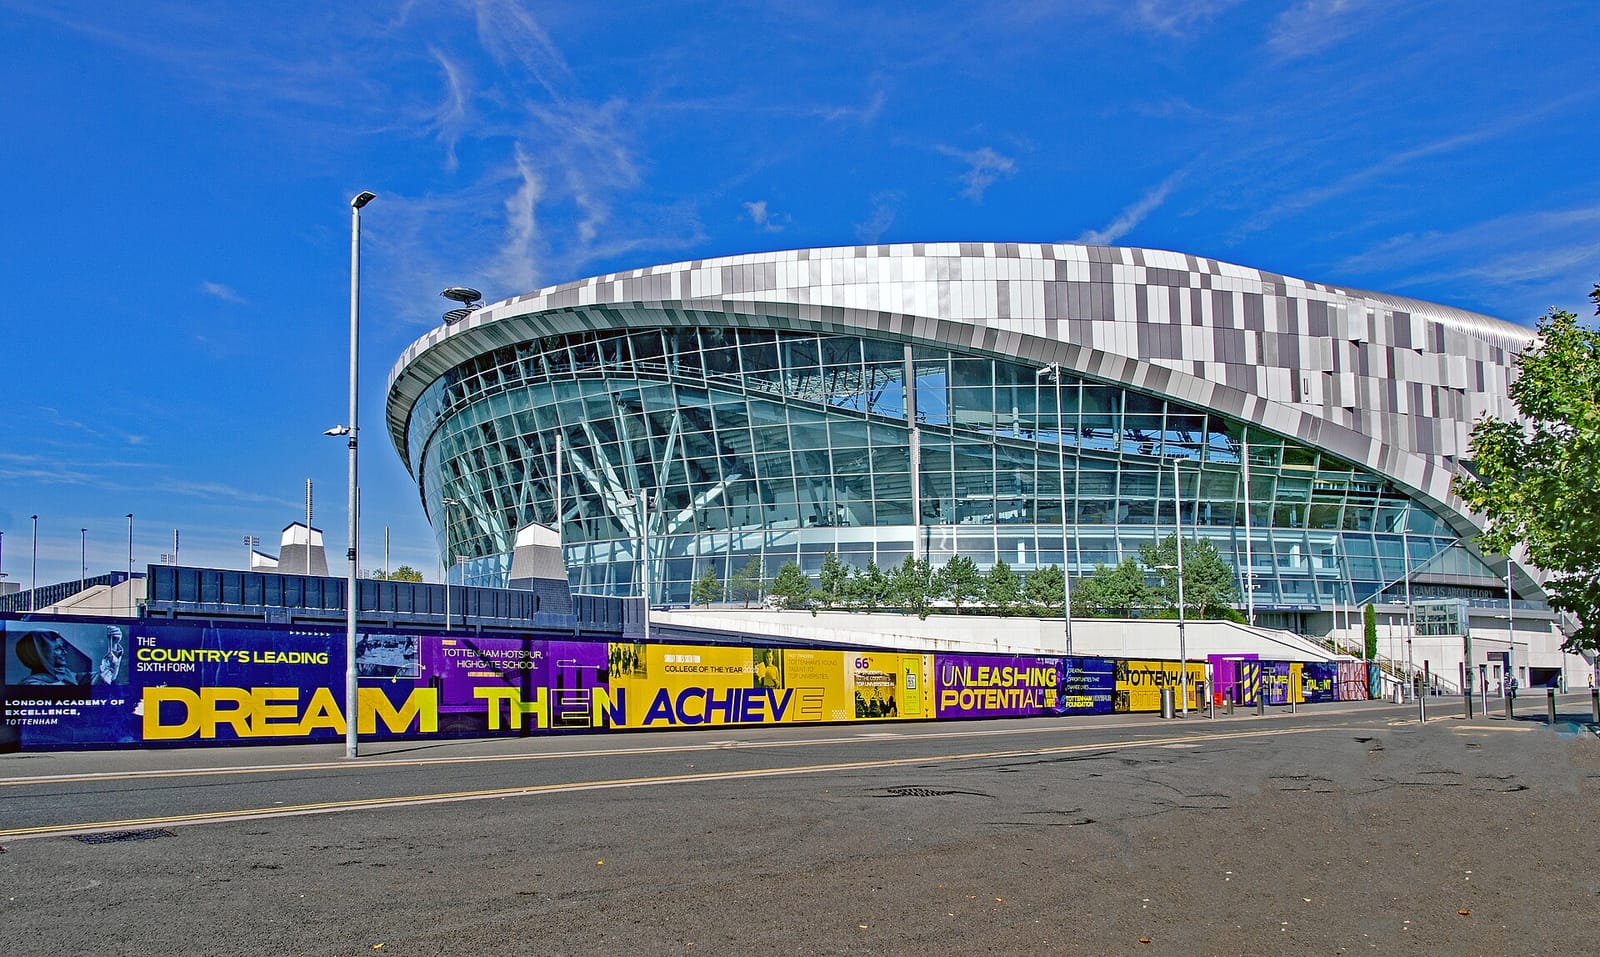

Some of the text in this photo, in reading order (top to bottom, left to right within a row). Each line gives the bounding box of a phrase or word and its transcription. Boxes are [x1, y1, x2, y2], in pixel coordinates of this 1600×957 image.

[1413, 585, 1436, 596] GAME
[1437, 586, 1445, 596] IS
[1447, 587, 1470, 597] ABOUT
[1471, 588, 1494, 598] GLORY
[137, 637, 156, 647] THE
[137, 648, 329, 665] COUNTRY'S LEADING
[442, 648, 544, 660] TOTTENHAM HOTSPUR,
[137, 662, 195, 673] SIXTH FORM
[457, 660, 501, 669] HIGHGATE
[664, 665, 697, 673] COLLEGE
[942, 665, 1057, 687] UNLEASHING
[642, 687, 825, 725] ACHIEVE
[941, 688, 1043, 711] POTENTIAL
[142, 687, 438, 740] DREAM
[473, 686, 626, 731] THEN
[6, 718, 58, 726] TOTTENHAM
